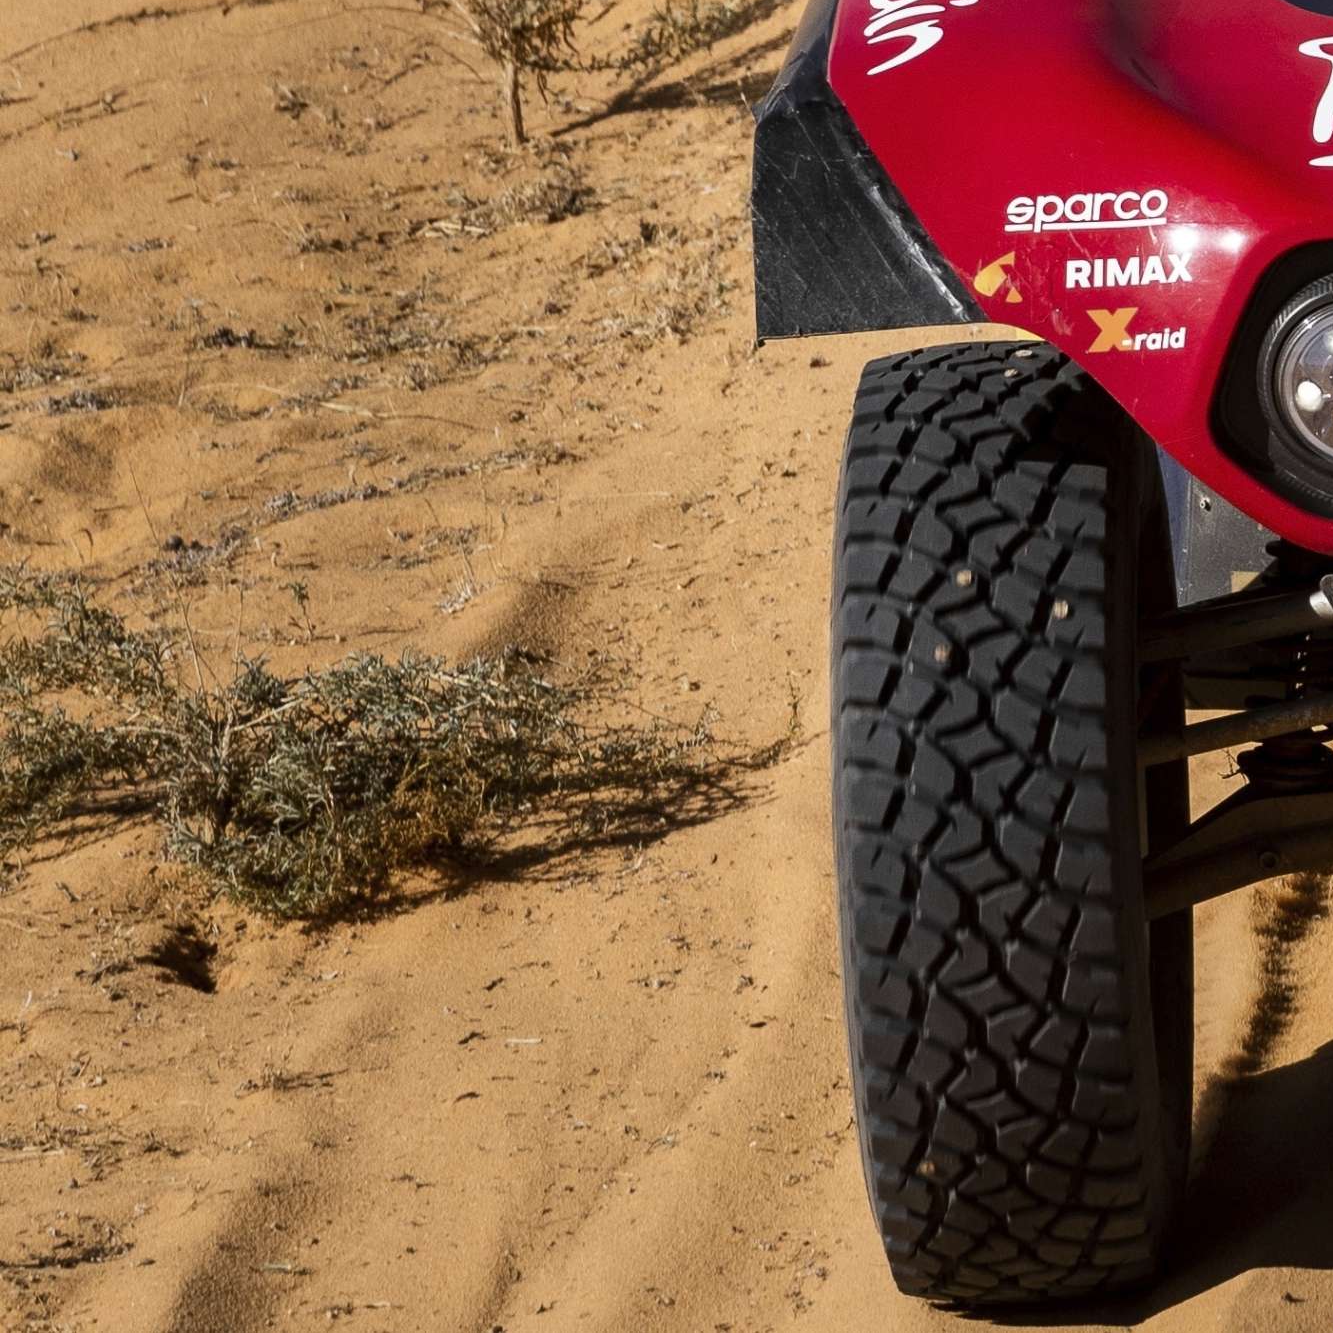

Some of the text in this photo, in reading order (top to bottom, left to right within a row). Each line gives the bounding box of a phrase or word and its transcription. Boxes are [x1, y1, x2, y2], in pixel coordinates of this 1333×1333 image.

[1005, 189, 1168, 233] sparco
[1065, 253, 1193, 289] RIMAX
[1086, 307, 1187, 353] X-raid
